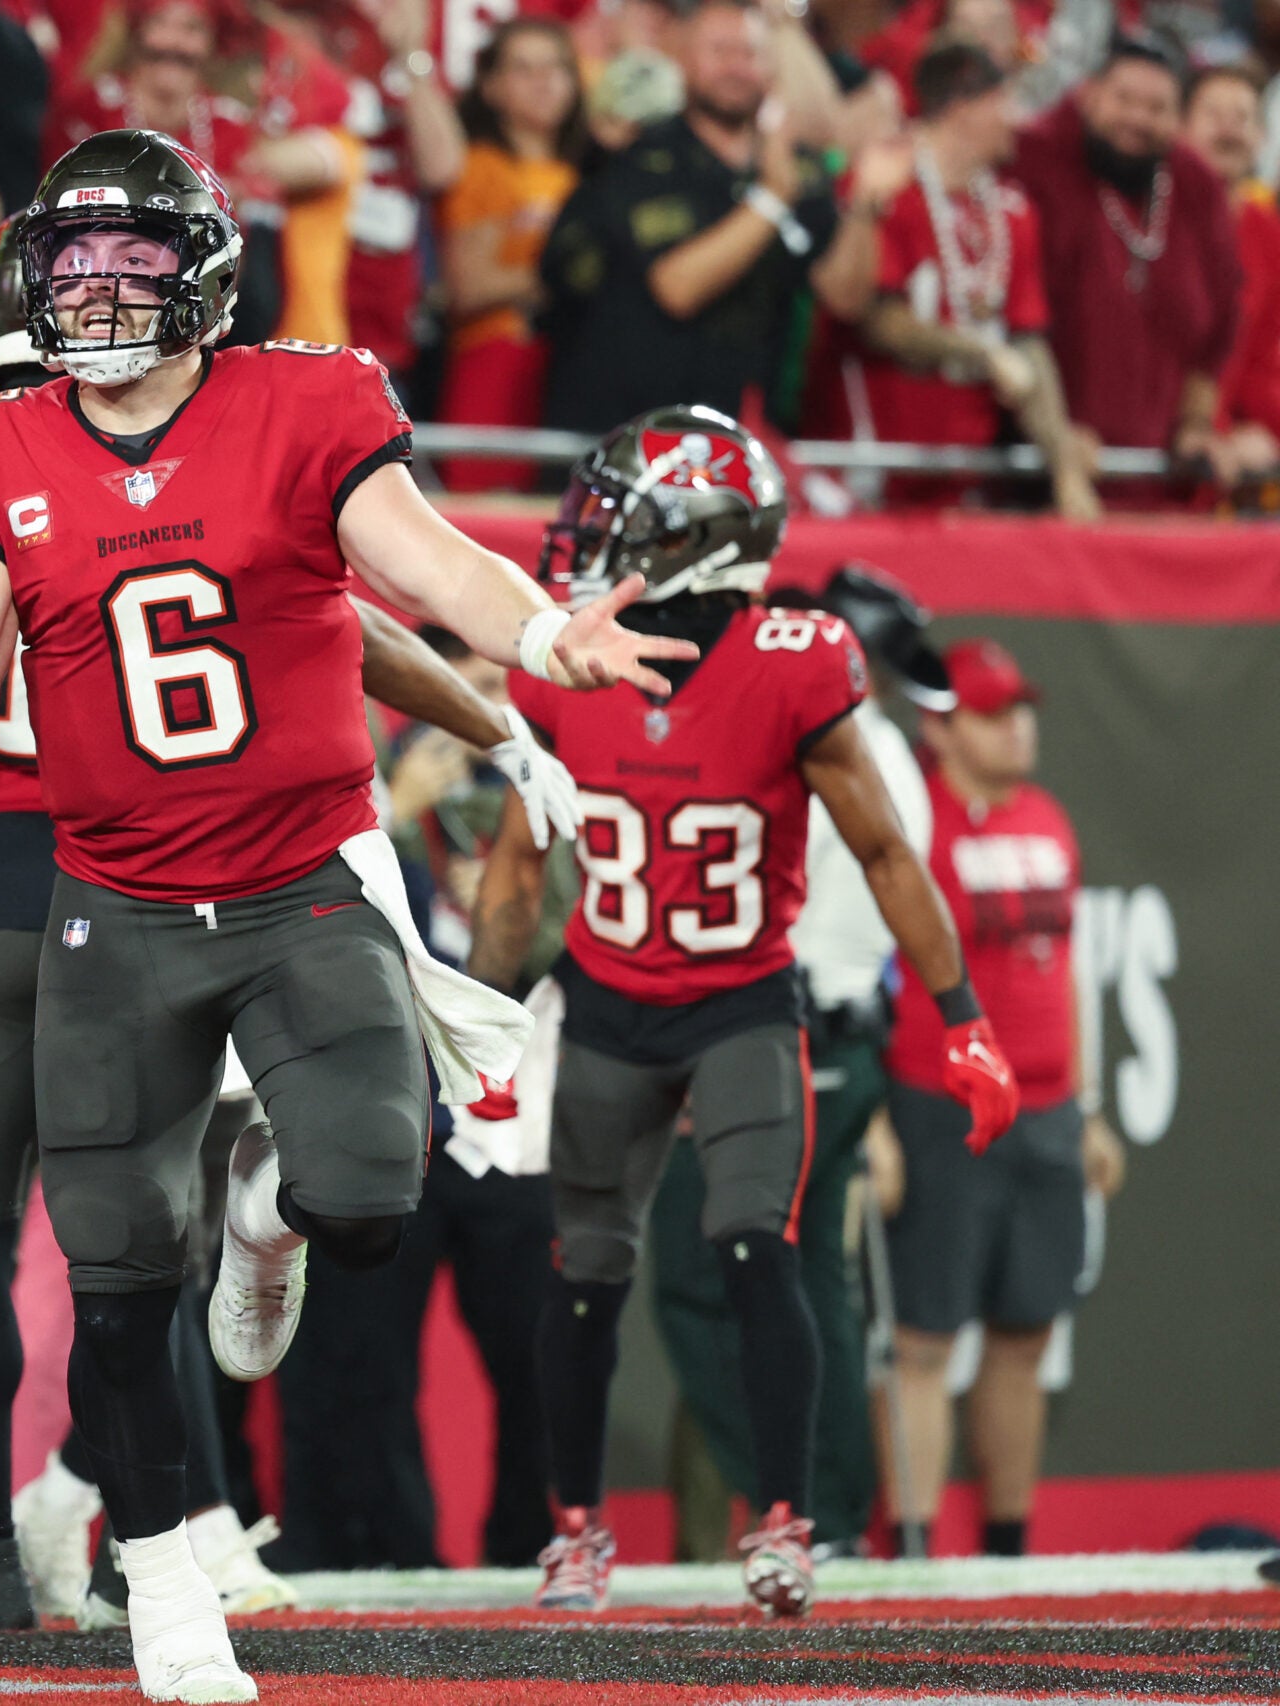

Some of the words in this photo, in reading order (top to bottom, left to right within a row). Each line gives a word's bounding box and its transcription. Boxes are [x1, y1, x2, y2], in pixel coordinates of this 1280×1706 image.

[76, 188, 106, 203] BUCS
[7, 496, 50, 538] C
[96, 518, 206, 559] BUCCANEERS
[98, 559, 259, 774] 6
[575, 783, 768, 960] 83
